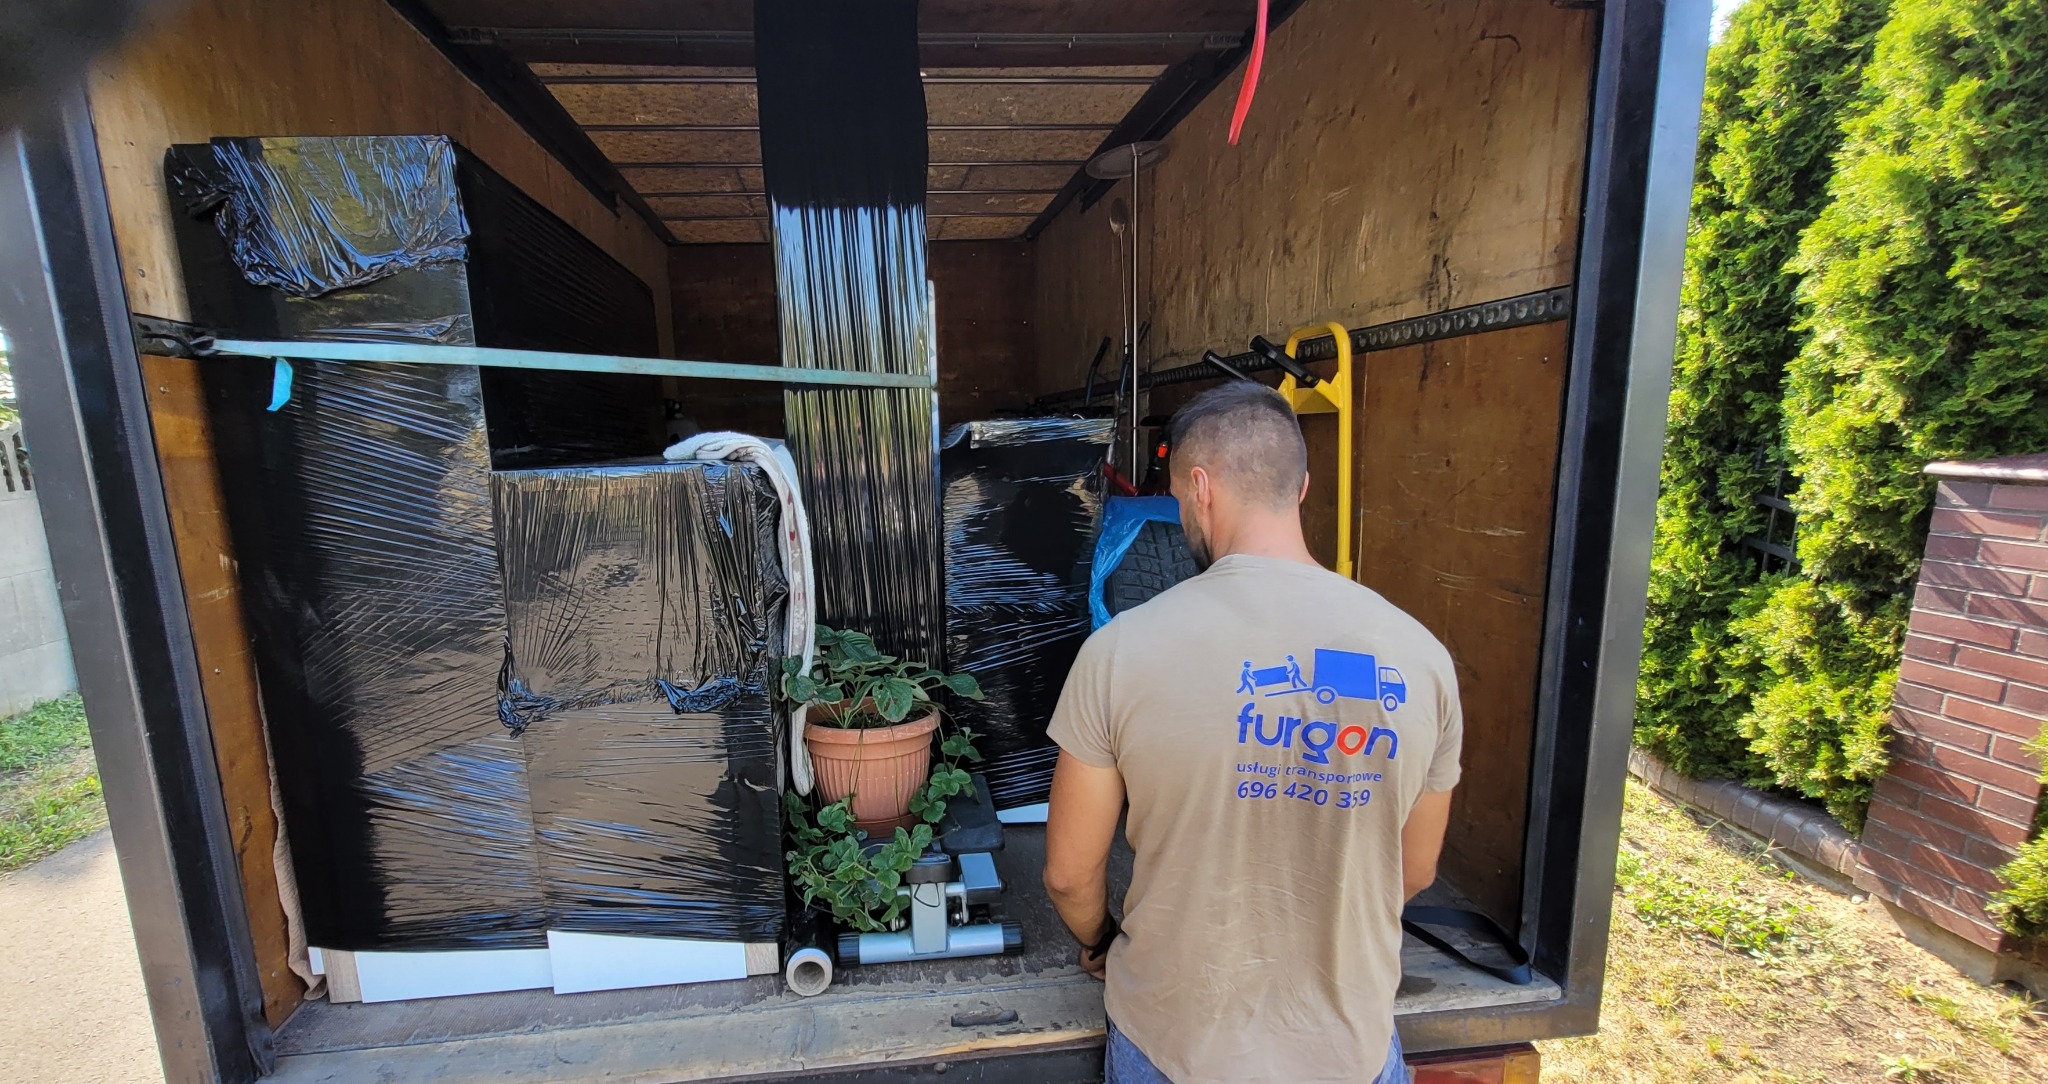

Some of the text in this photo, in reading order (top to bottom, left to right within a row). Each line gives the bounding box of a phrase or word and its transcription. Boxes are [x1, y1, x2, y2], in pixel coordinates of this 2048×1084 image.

[1237, 702, 1398, 764] furgon
[1236, 761, 1382, 784] usługi transportowe
[1237, 781, 1371, 809] 696 420 359
